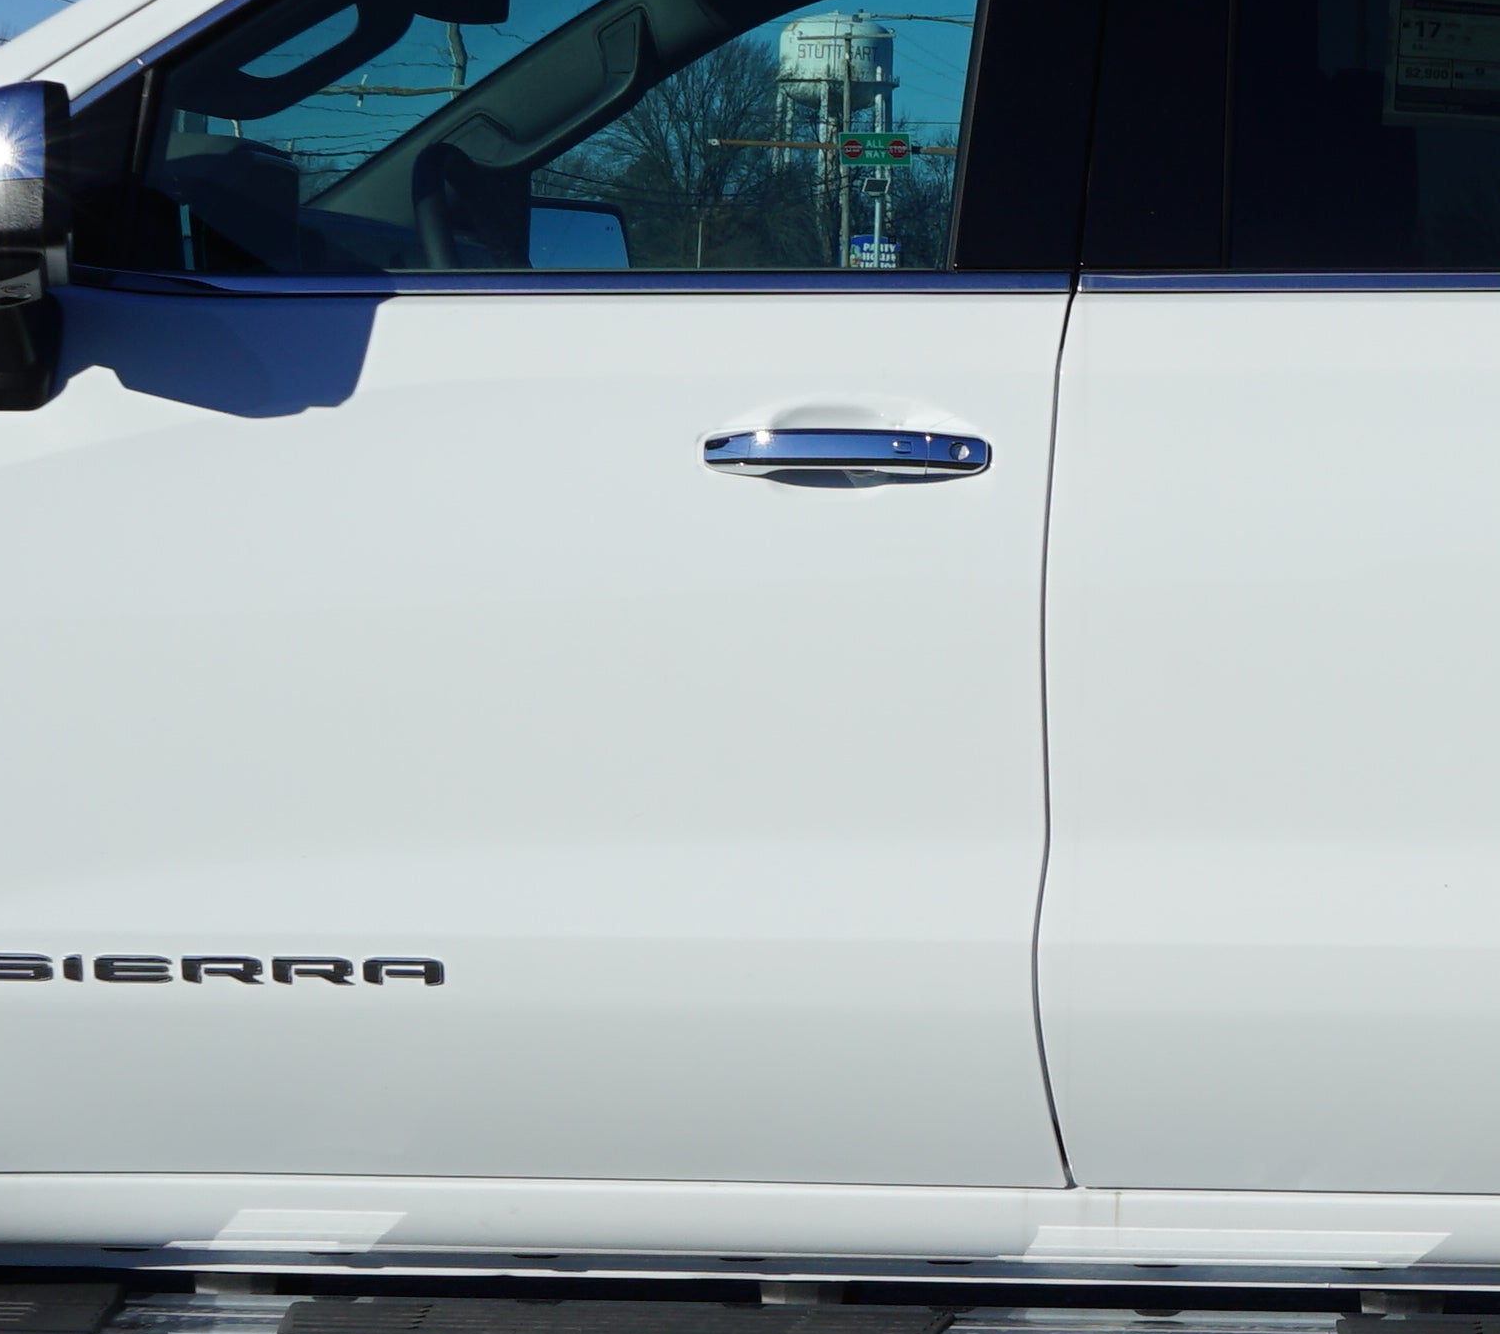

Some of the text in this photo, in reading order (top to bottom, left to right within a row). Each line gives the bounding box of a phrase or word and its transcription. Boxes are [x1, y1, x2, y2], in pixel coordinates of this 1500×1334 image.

[1414, 20, 1442, 39] 17
[865, 139, 885, 149] ALL
[864, 150, 886, 159] WAY
